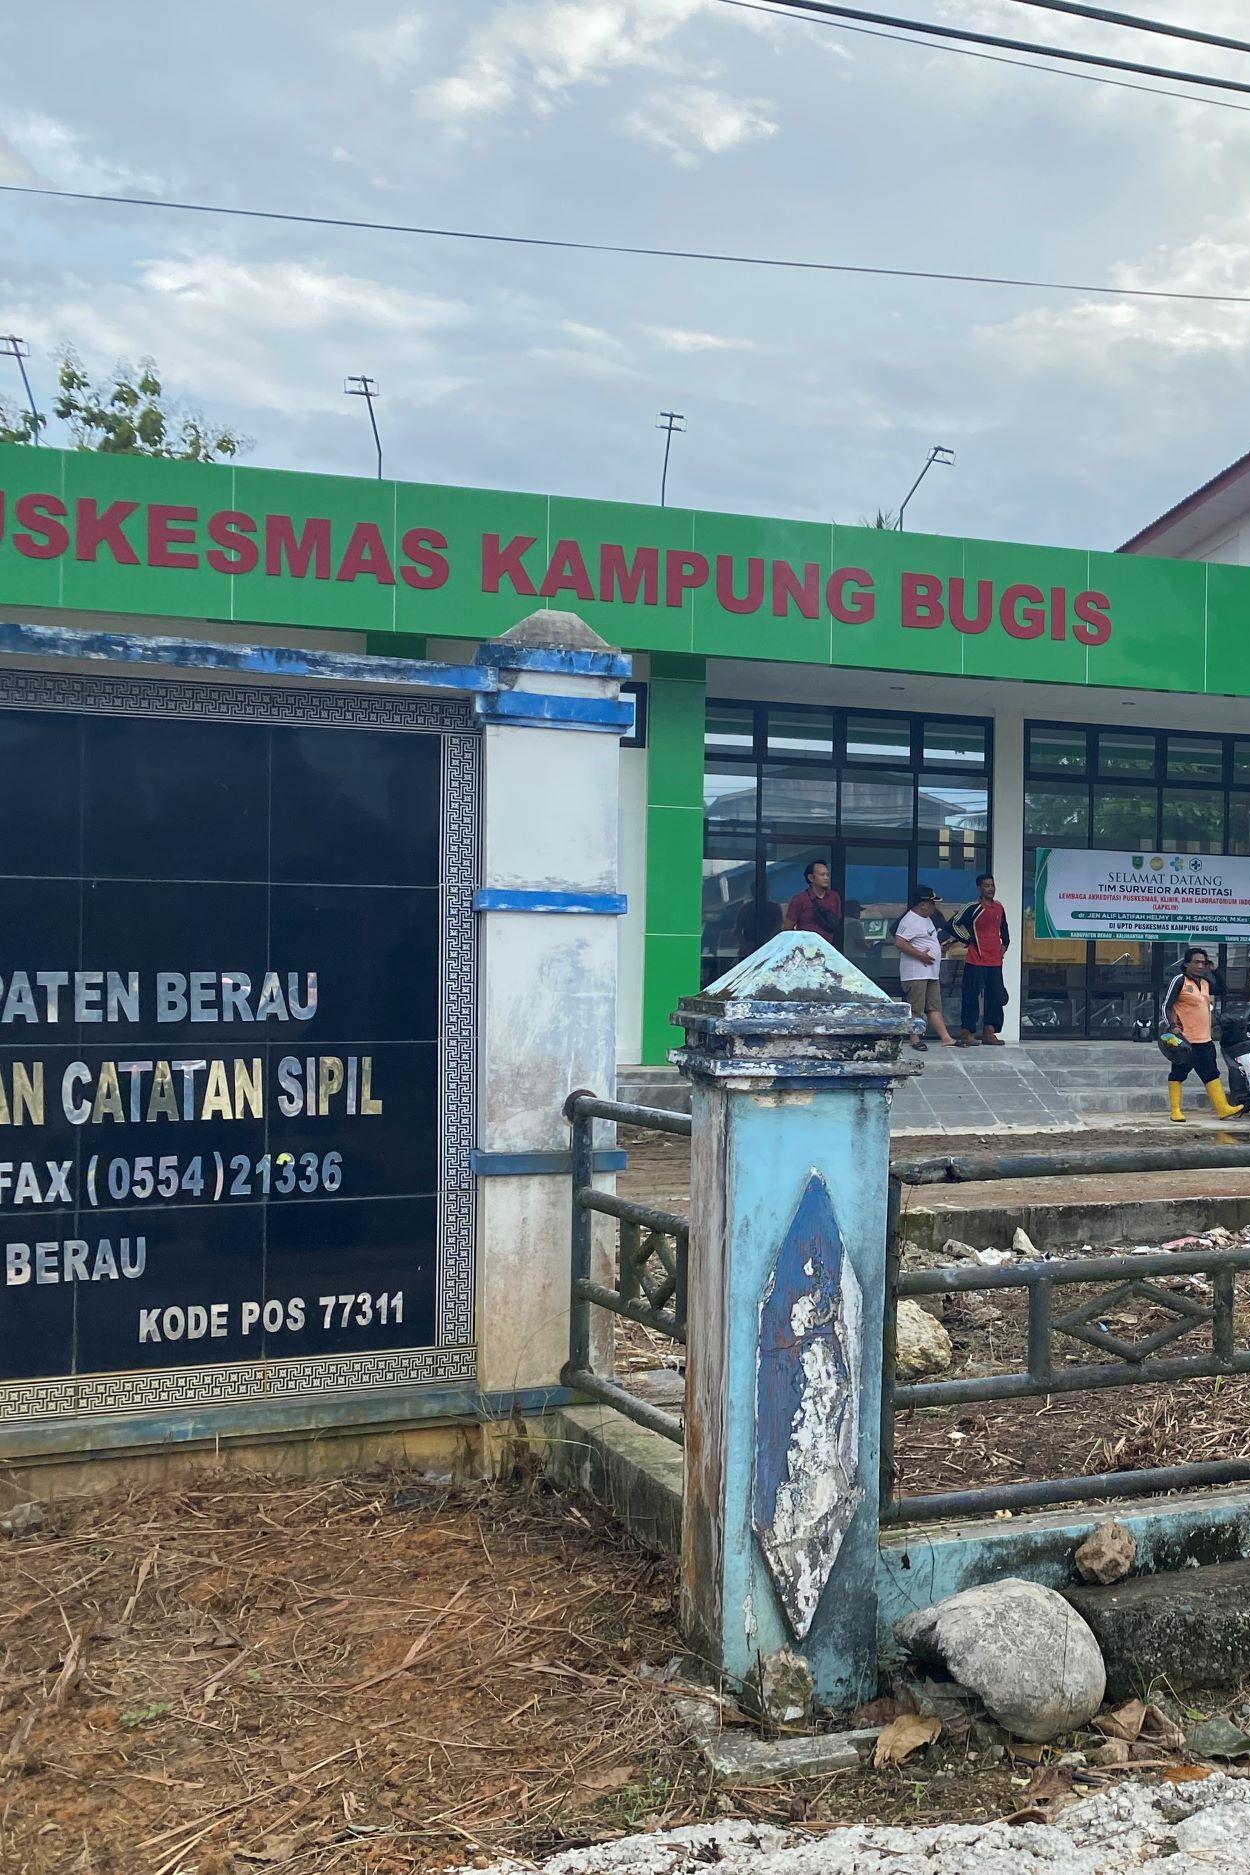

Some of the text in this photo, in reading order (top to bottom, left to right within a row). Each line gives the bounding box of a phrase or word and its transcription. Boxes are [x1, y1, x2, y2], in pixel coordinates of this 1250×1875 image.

[0, 490, 1113, 646] SKESMAS KAMPUNG BUGIS
[1059, 892, 1087, 900] LEMBAGA
[1088, 893, 1122, 901] AKREDITASI
[1123, 894, 1159, 903] PUSKESMAS,
[1194, 897, 1238, 905] LABORATORIUM
[1098, 884, 1232, 897] TIM SURVEIOR AKREDITASI
[1108, 872, 1222, 887] SELAMAT DATANG
[1134, 923, 1170, 931] PUSKESMAS
[0, 971, 319, 1023] ATEN BERAU
[61, 1058, 264, 1125] CATATAN
[277, 1056, 383, 1118] SIPIL
[6, 1236, 147, 1286] BERAU
[139, 1291, 403, 1343] KODE POS 77311
